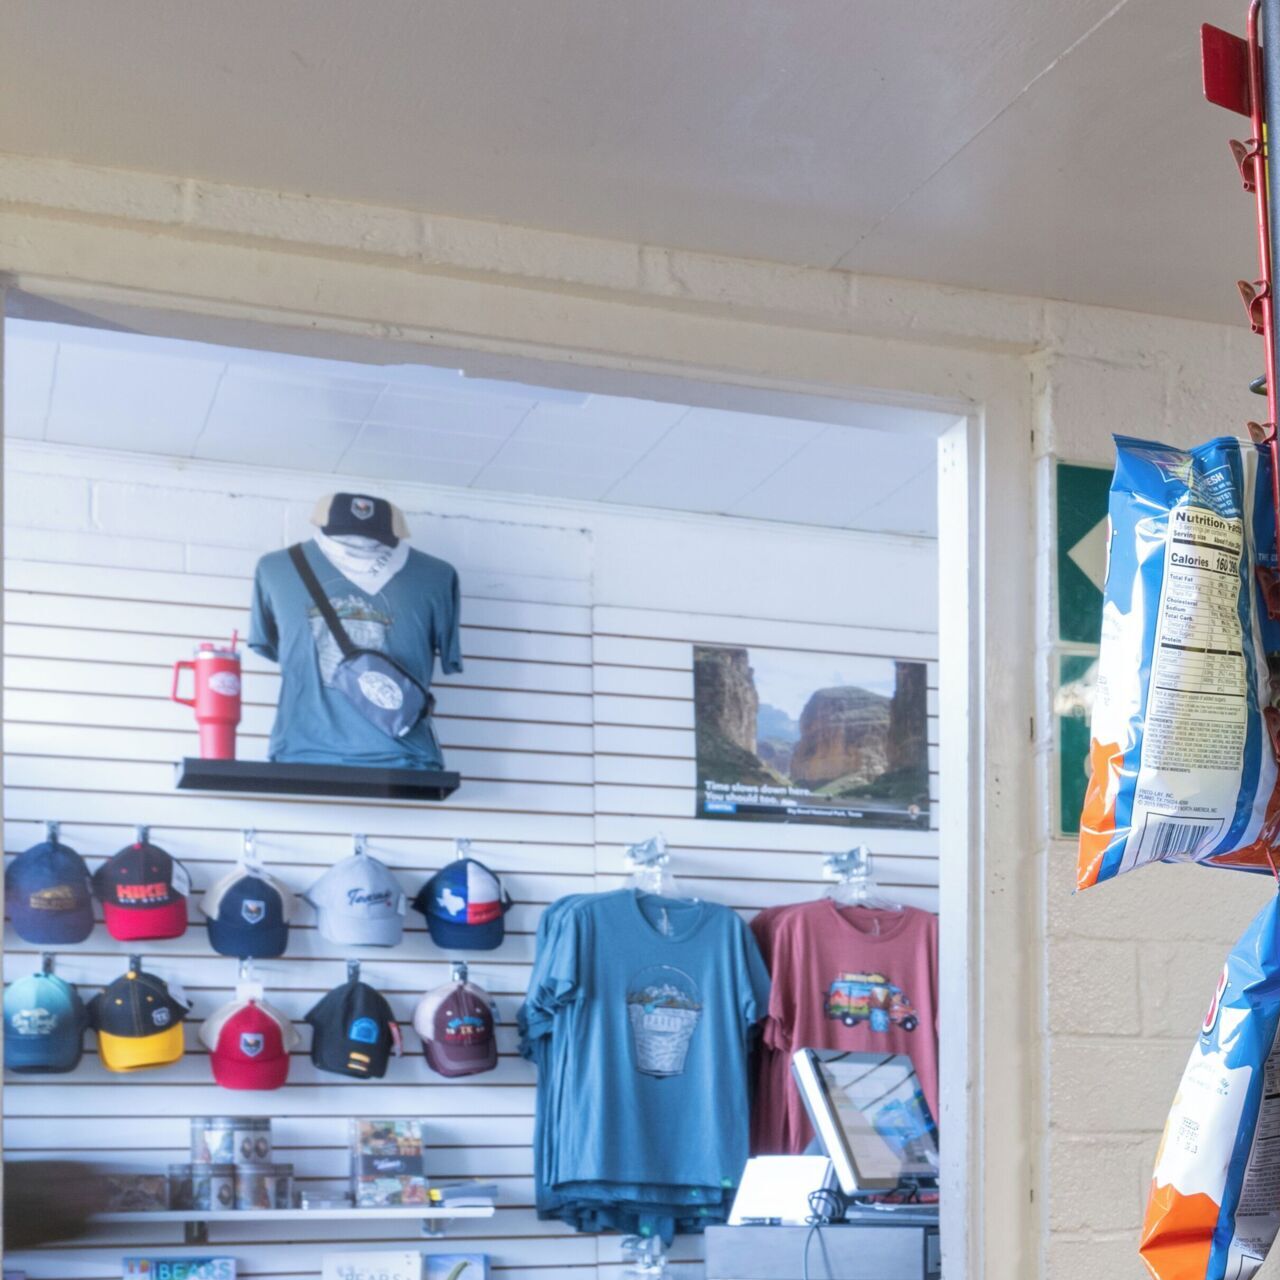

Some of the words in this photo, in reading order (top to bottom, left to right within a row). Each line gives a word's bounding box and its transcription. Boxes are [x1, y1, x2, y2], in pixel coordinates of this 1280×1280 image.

[1175, 512, 1226, 530] Nutrition
[1171, 553, 1209, 568] Calories
[116, 883, 168, 899] HIKE
[159, 1262, 233, 1280] BEARS
